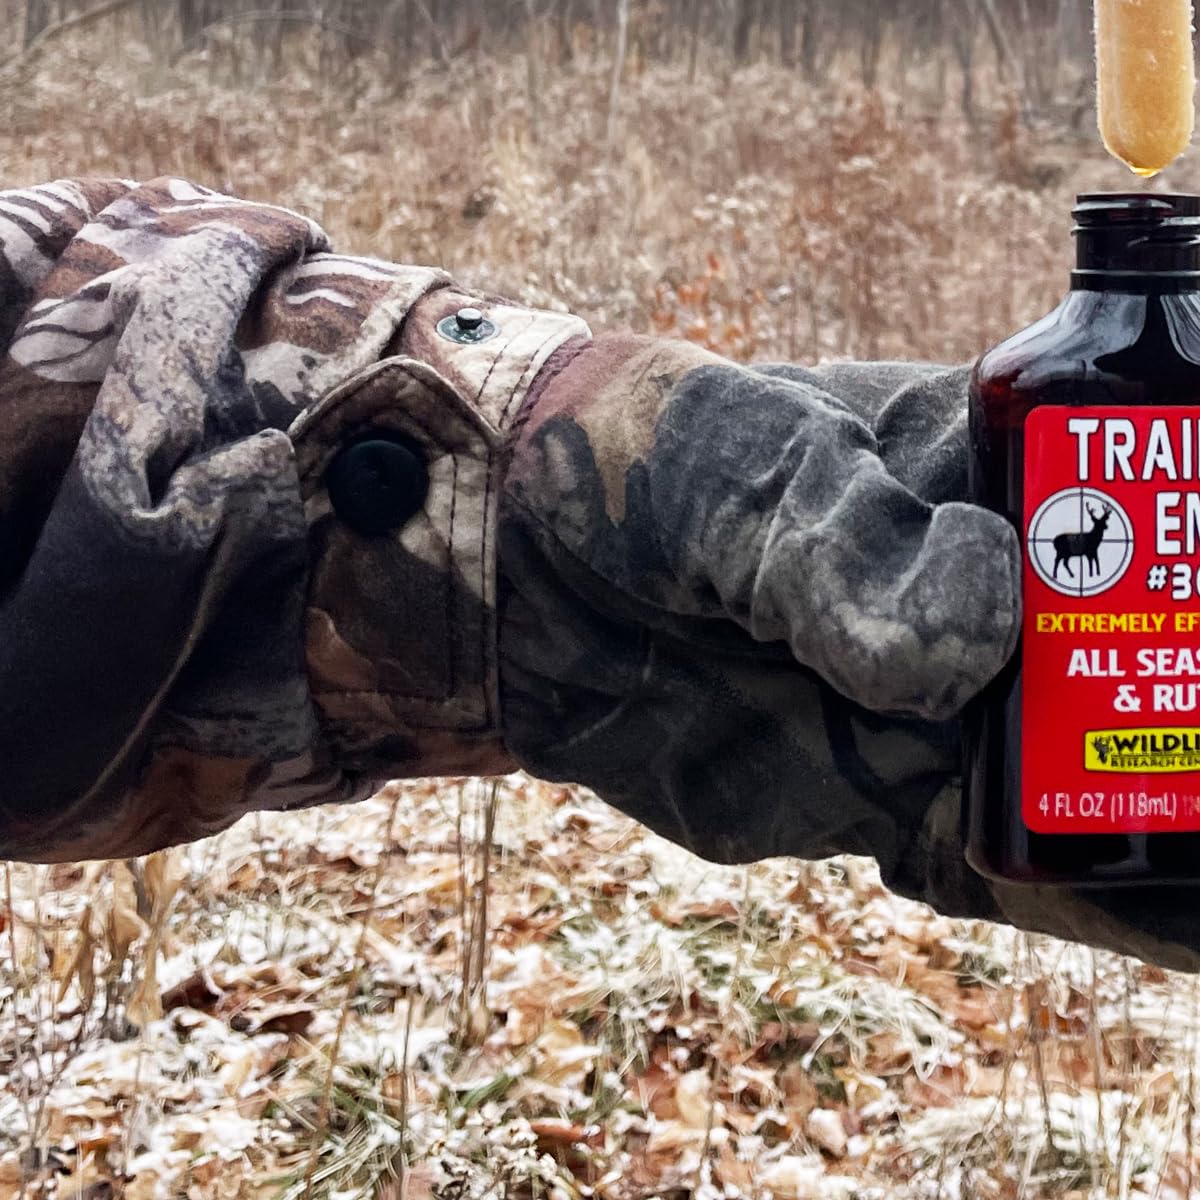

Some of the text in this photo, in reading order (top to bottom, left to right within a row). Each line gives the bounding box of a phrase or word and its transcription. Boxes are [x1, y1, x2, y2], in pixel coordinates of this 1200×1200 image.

[1036, 613, 1166, 633] EXTREMELY
[1067, 648, 1126, 677] ALL
[1113, 684, 1141, 712] &
[1038, 793, 1050, 816] 4
[1055, 793, 1073, 817] FL
[1079, 793, 1105, 817] OZ
[1110, 792, 1177, 823] (118mL)
